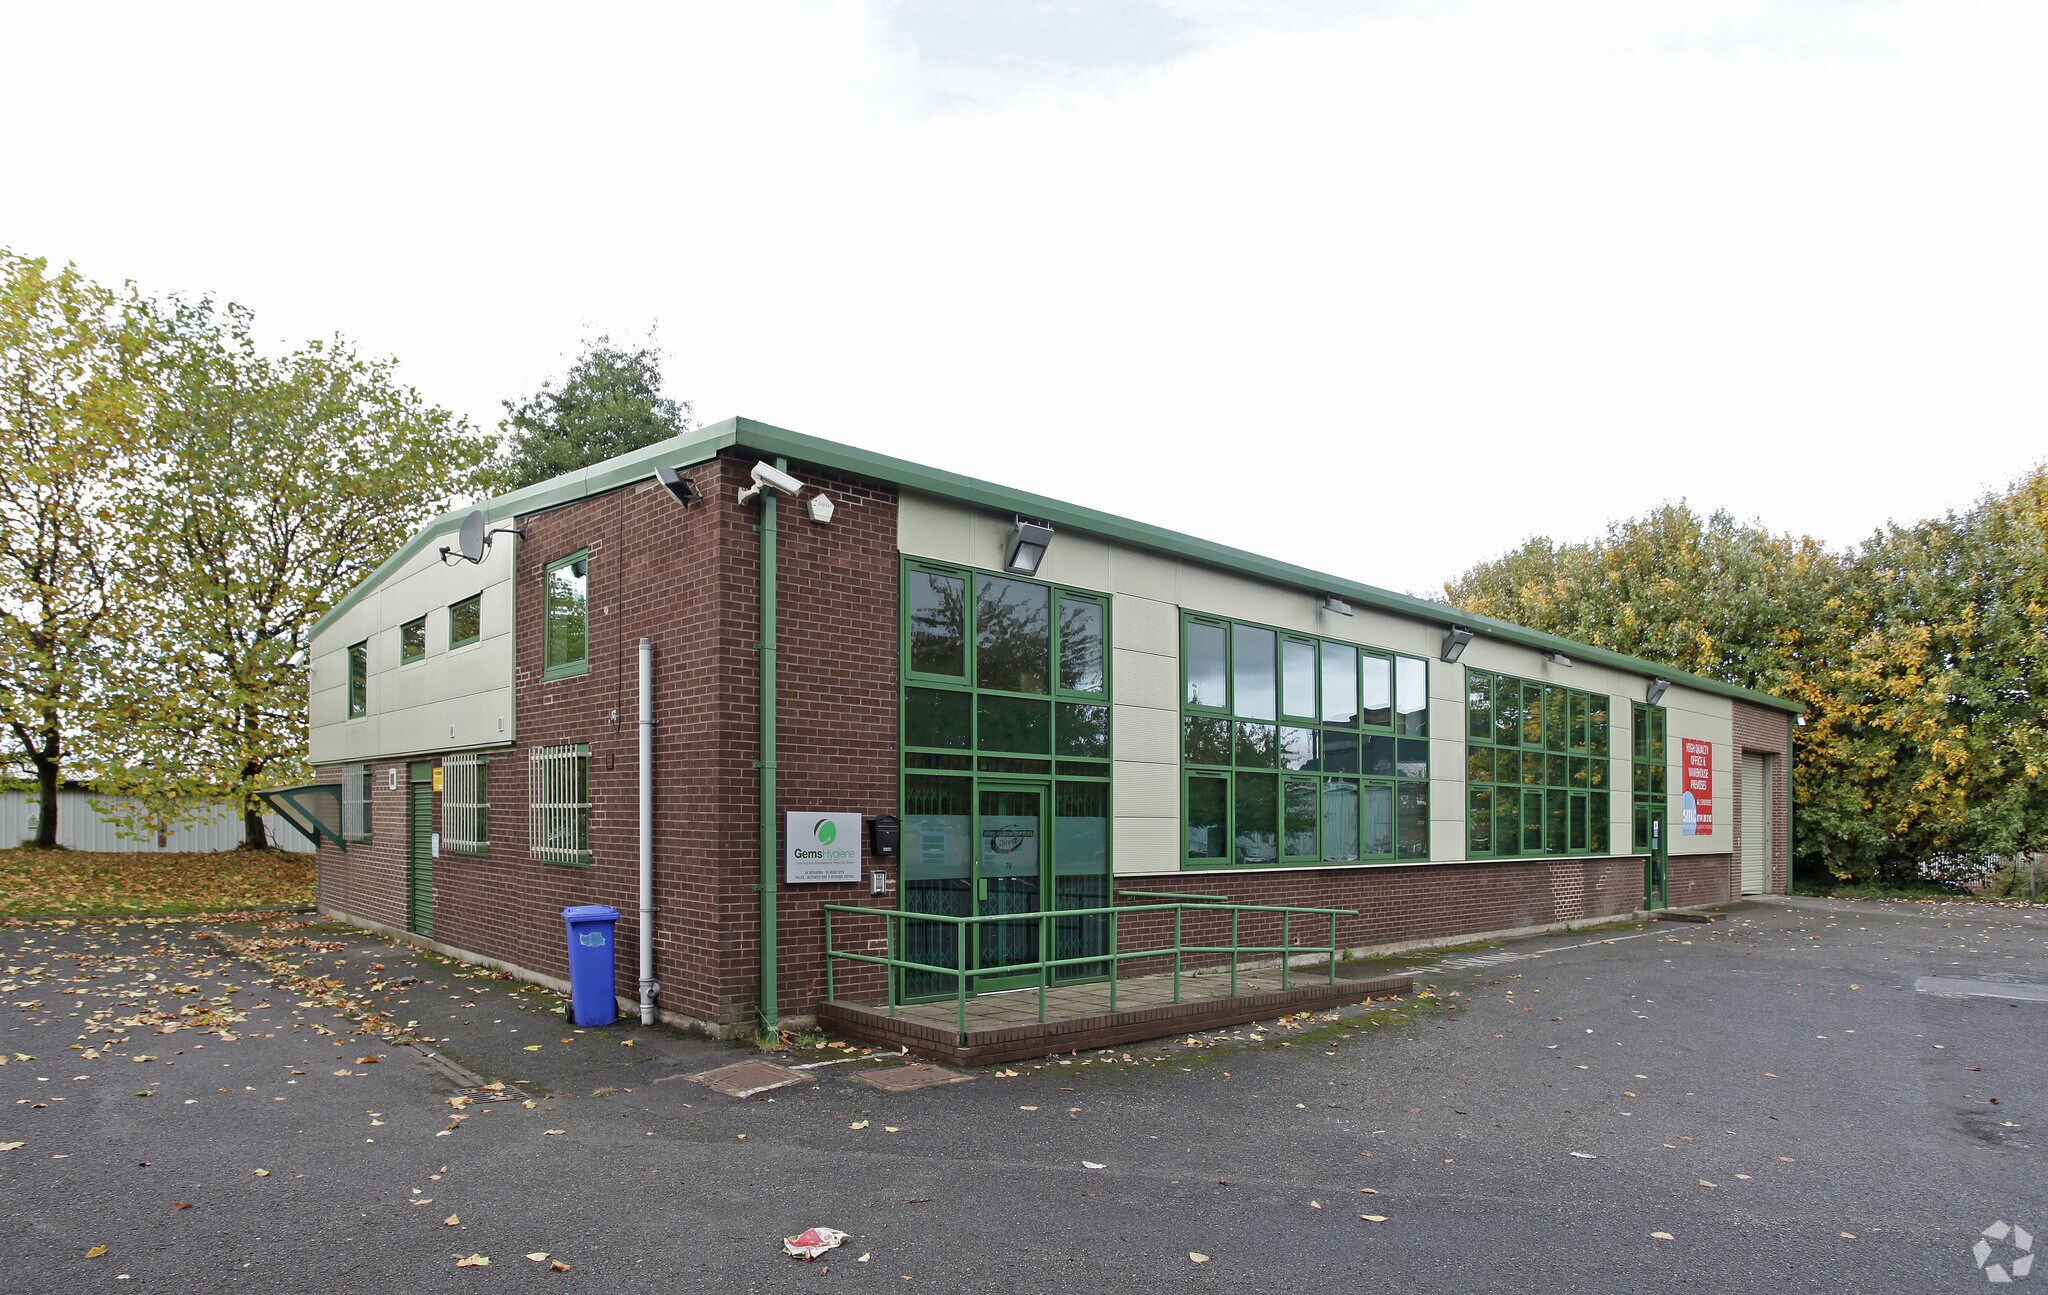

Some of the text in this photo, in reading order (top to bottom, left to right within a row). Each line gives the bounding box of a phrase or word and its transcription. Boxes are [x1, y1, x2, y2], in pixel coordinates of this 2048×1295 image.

[1696, 744, 1708, 754] QUALITY
[1690, 755, 1702, 766] OFFICE
[1688, 767, 1709, 778] WAREHOUSE
[1690, 779, 1707, 790] PREMISES
[794, 848, 855, 861] GemsHygiene
